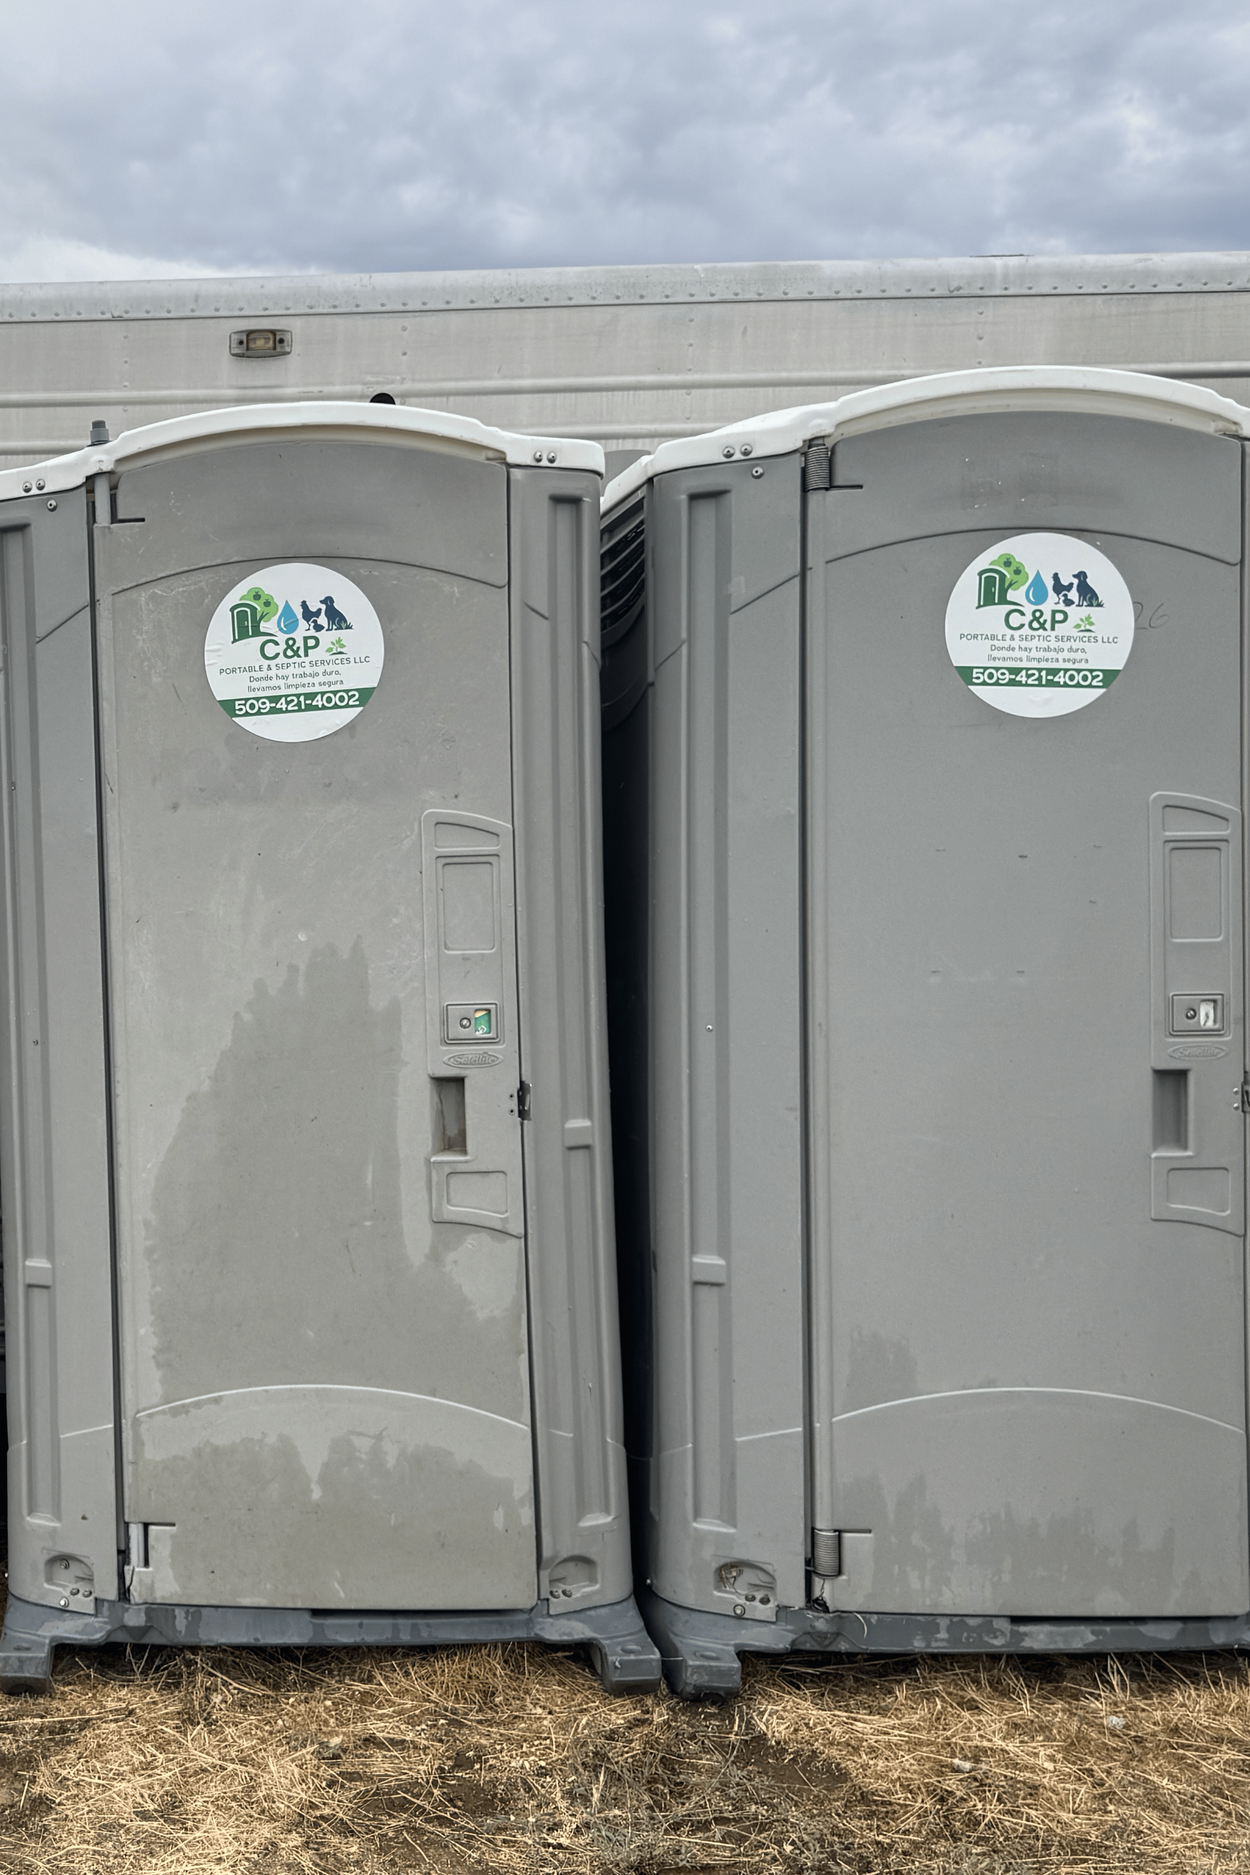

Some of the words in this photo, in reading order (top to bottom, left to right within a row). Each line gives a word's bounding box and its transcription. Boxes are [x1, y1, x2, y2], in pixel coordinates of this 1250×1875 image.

[1004, 609, 1068, 631] C&P
[960, 634, 1007, 642] PORTABLE
[1054, 635, 1098, 643] SERVICES
[1101, 636, 1118, 644] LLC
[259, 636, 320, 661] C&P
[1018, 645, 1032, 653] hay
[1035, 645, 1064, 654] trabajo
[1067, 646, 1087, 654] duro,
[219, 665, 263, 675] PORTABLE
[275, 662, 306, 670] SEPTIC
[309, 657, 351, 668] SERVICES
[354, 656, 370, 664] LLC
[1026, 655, 1059, 664] limpieza
[249, 674, 273, 683] Donde
[275, 672, 289, 682] hay
[292, 671, 319, 679] trabajo
[322, 669, 341, 677] duro,
[972, 668, 1103, 686] 509-421-4002
[248, 684, 281, 692] llevamos
[284, 681, 315, 690] limpieza
[318, 679, 343, 687] segura
[235, 691, 359, 715] 509-421-4002
